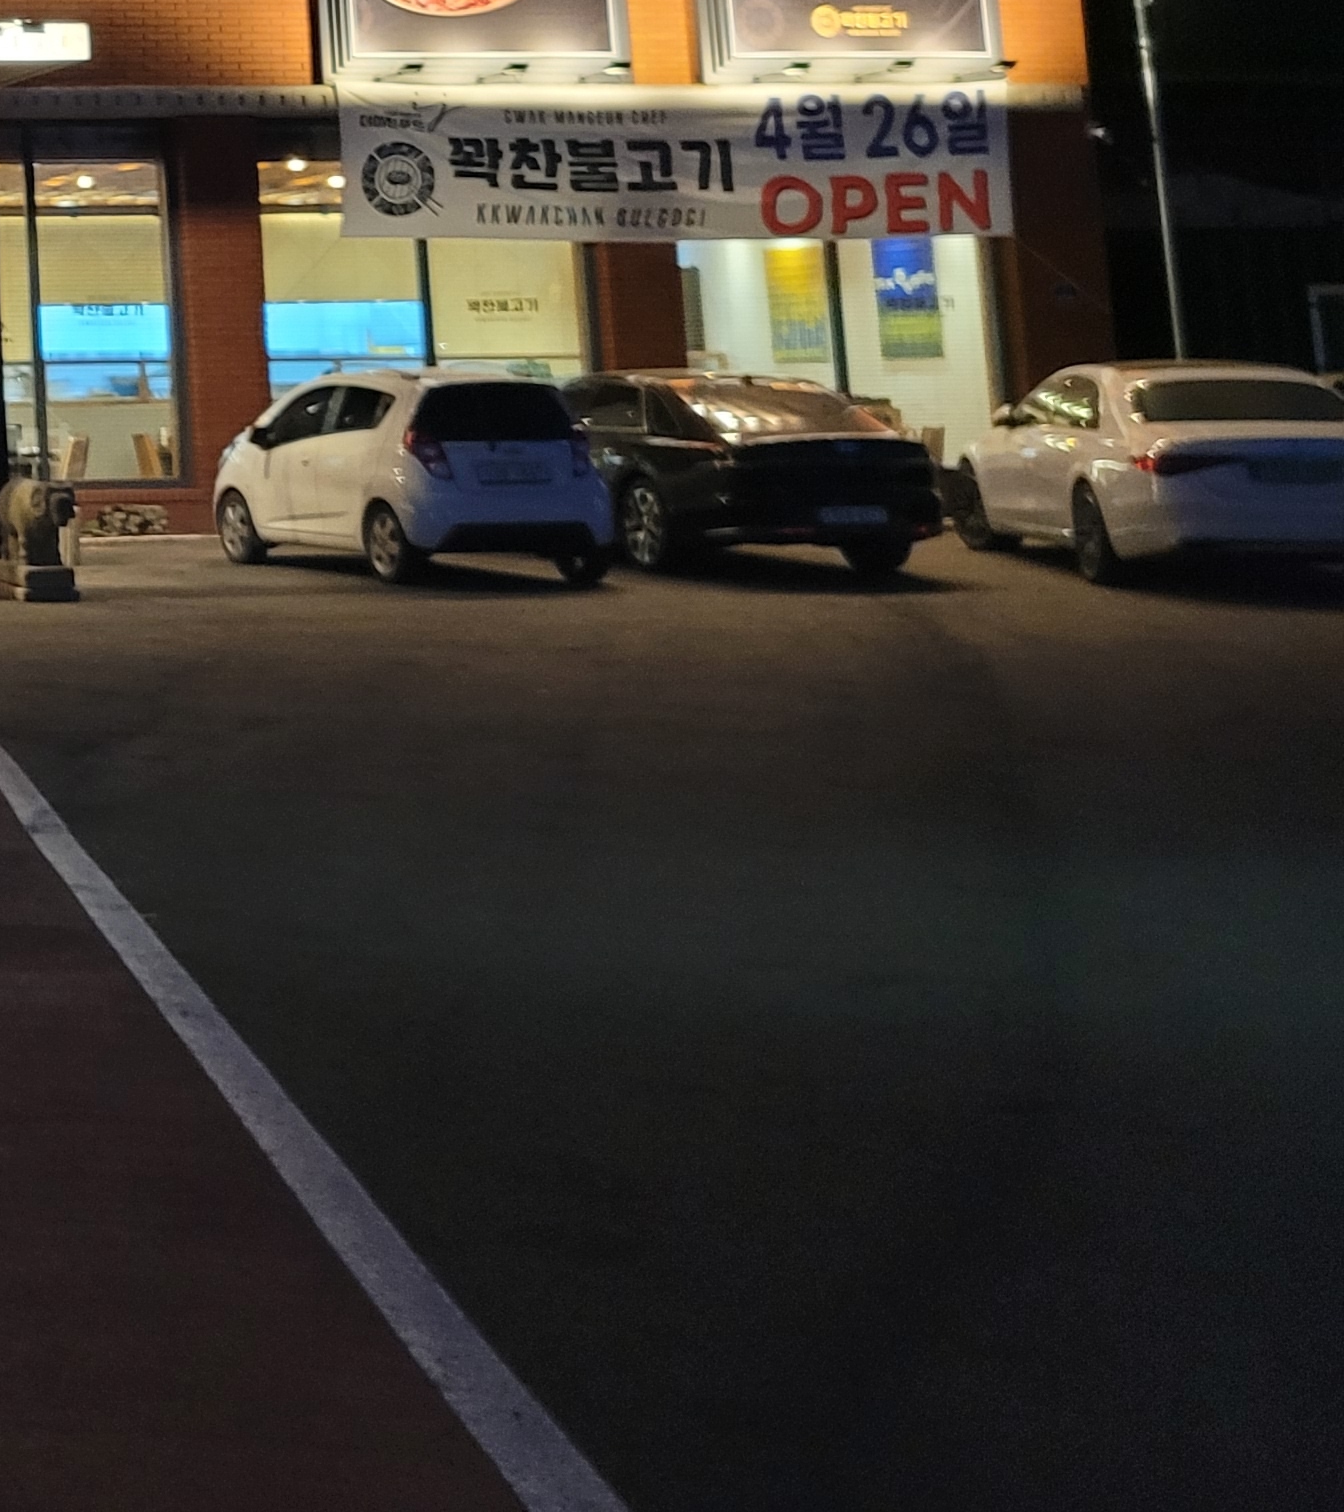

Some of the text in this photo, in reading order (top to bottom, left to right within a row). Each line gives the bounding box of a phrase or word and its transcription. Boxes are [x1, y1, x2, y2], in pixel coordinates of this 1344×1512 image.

[755, 89, 990, 161] 4월 26일
[448, 137, 734, 192] 꽉찬불고기
[476, 202, 606, 228] KKWAKCHAN
[761, 169, 992, 236] OPEN
